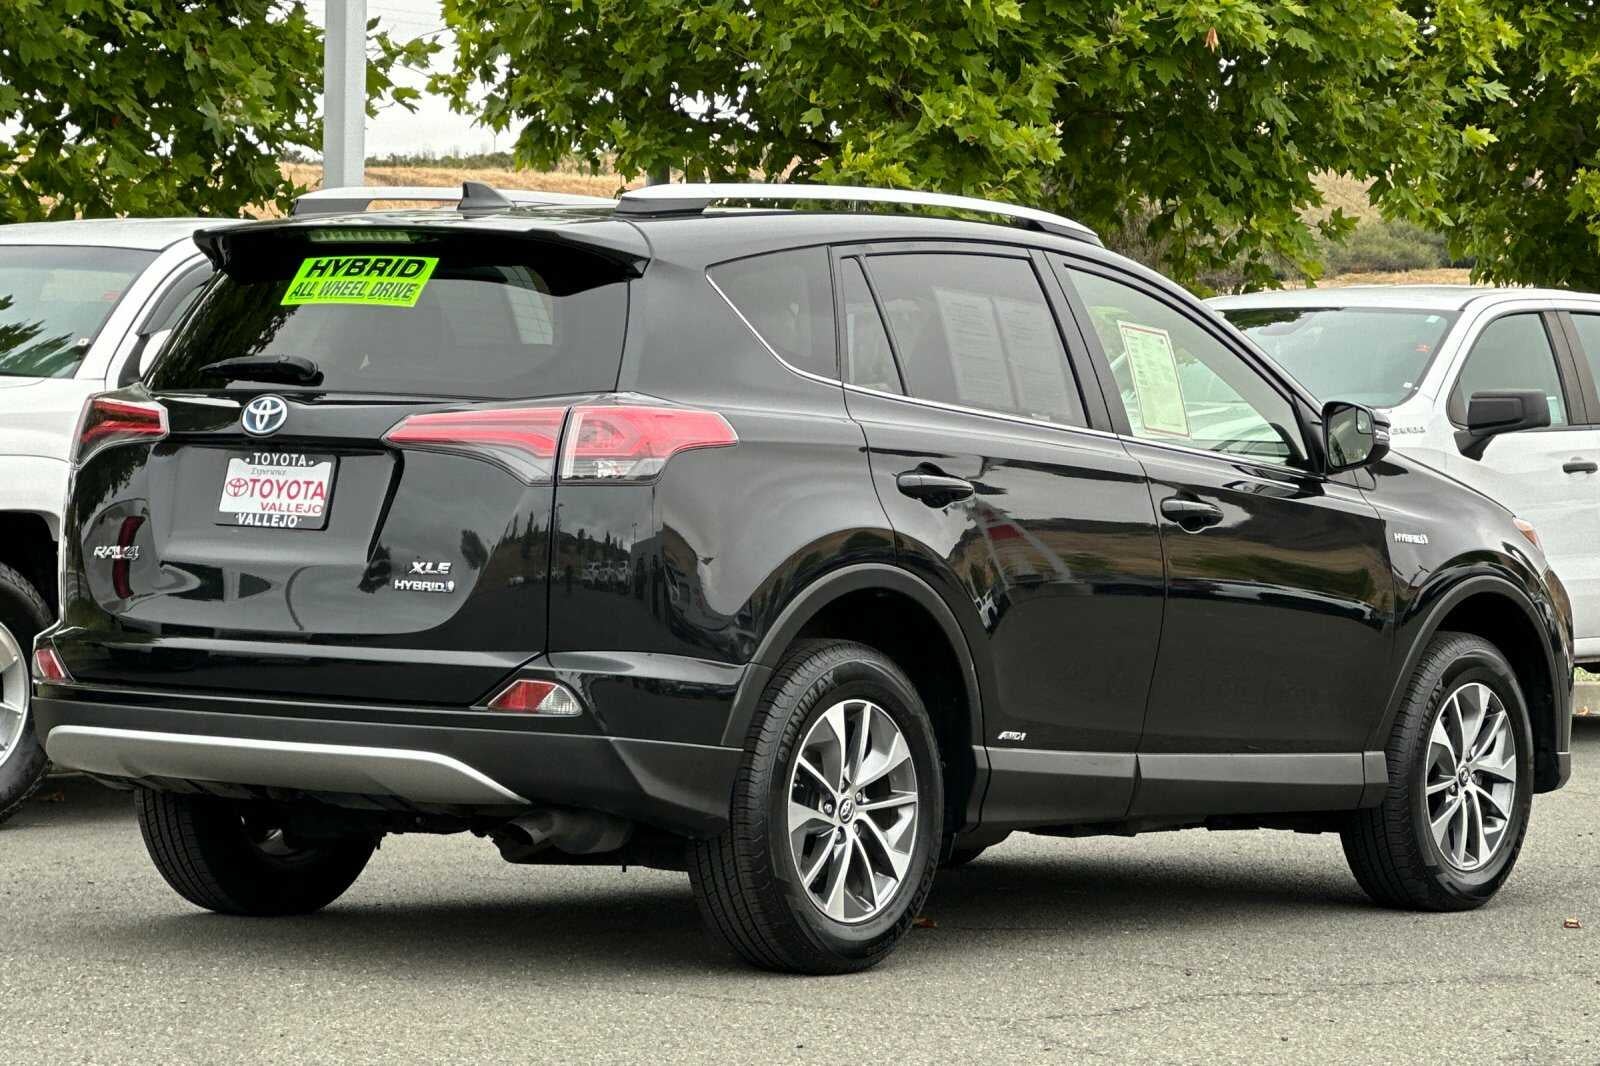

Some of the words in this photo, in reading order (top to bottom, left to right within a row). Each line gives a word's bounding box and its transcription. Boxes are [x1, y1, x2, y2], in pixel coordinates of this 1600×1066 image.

[304, 257, 427, 278] HYBRID
[289, 281, 319, 297] ALL
[319, 280, 370, 297] WHEEL
[369, 281, 418, 299] DRIVE
[253, 453, 306, 466] TOYOTA
[249, 478, 325, 500] TOYOTA
[261, 502, 324, 514] VALLEJO
[238, 512, 298, 528] VALLEJO
[94, 545, 139, 560] RAV4
[408, 561, 451, 574] XLE
[394, 579, 445, 592] HYBRID
